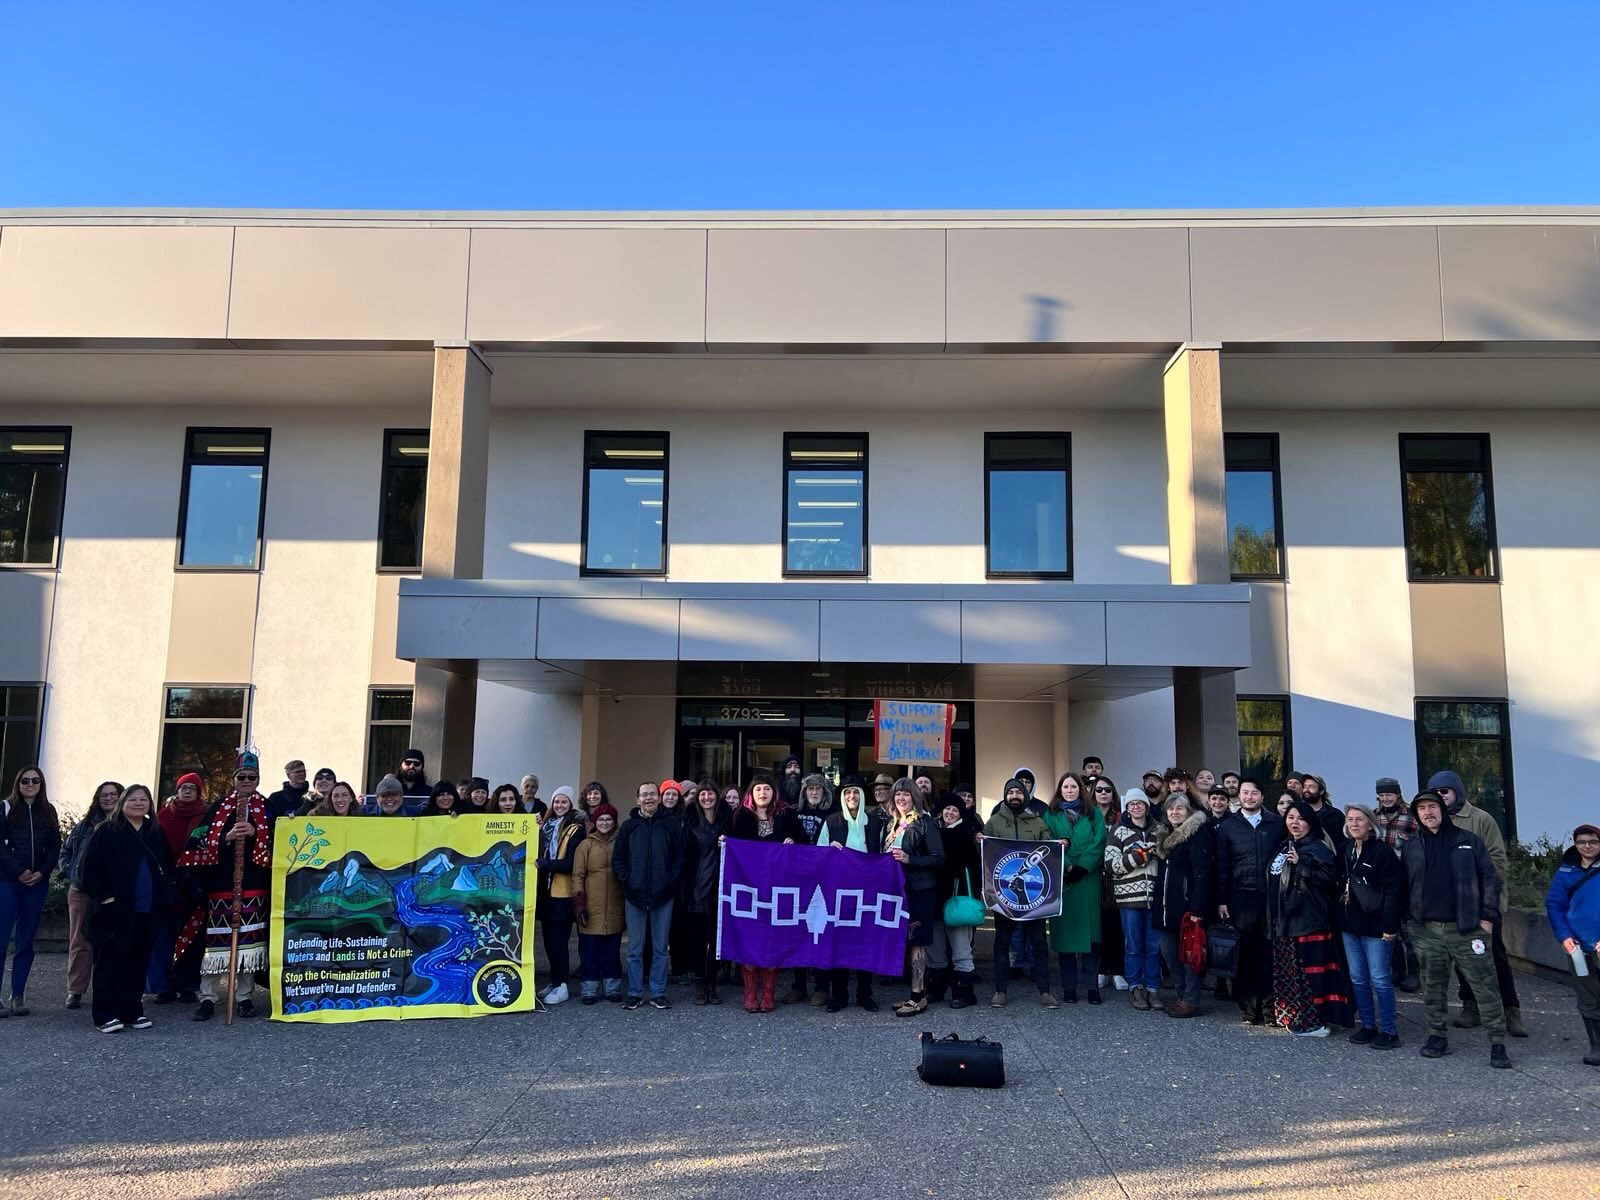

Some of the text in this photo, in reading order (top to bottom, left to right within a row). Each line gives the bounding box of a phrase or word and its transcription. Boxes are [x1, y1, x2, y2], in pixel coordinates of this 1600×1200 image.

[721, 708, 760, 720] 3793
[889, 702, 944, 716] SUPPORT
[288, 936, 388, 949] Defending Life-Sustaining
[288, 952, 314, 963] Waters
[316, 952, 330, 961] and
[332, 951, 355, 961] Lands
[358, 950, 364, 960] is
[366, 949, 381, 960] Not
[285, 968, 390, 983] Stop the Criminalization of
[285, 982, 396, 997] Wet'suwet'en Land Defenders
